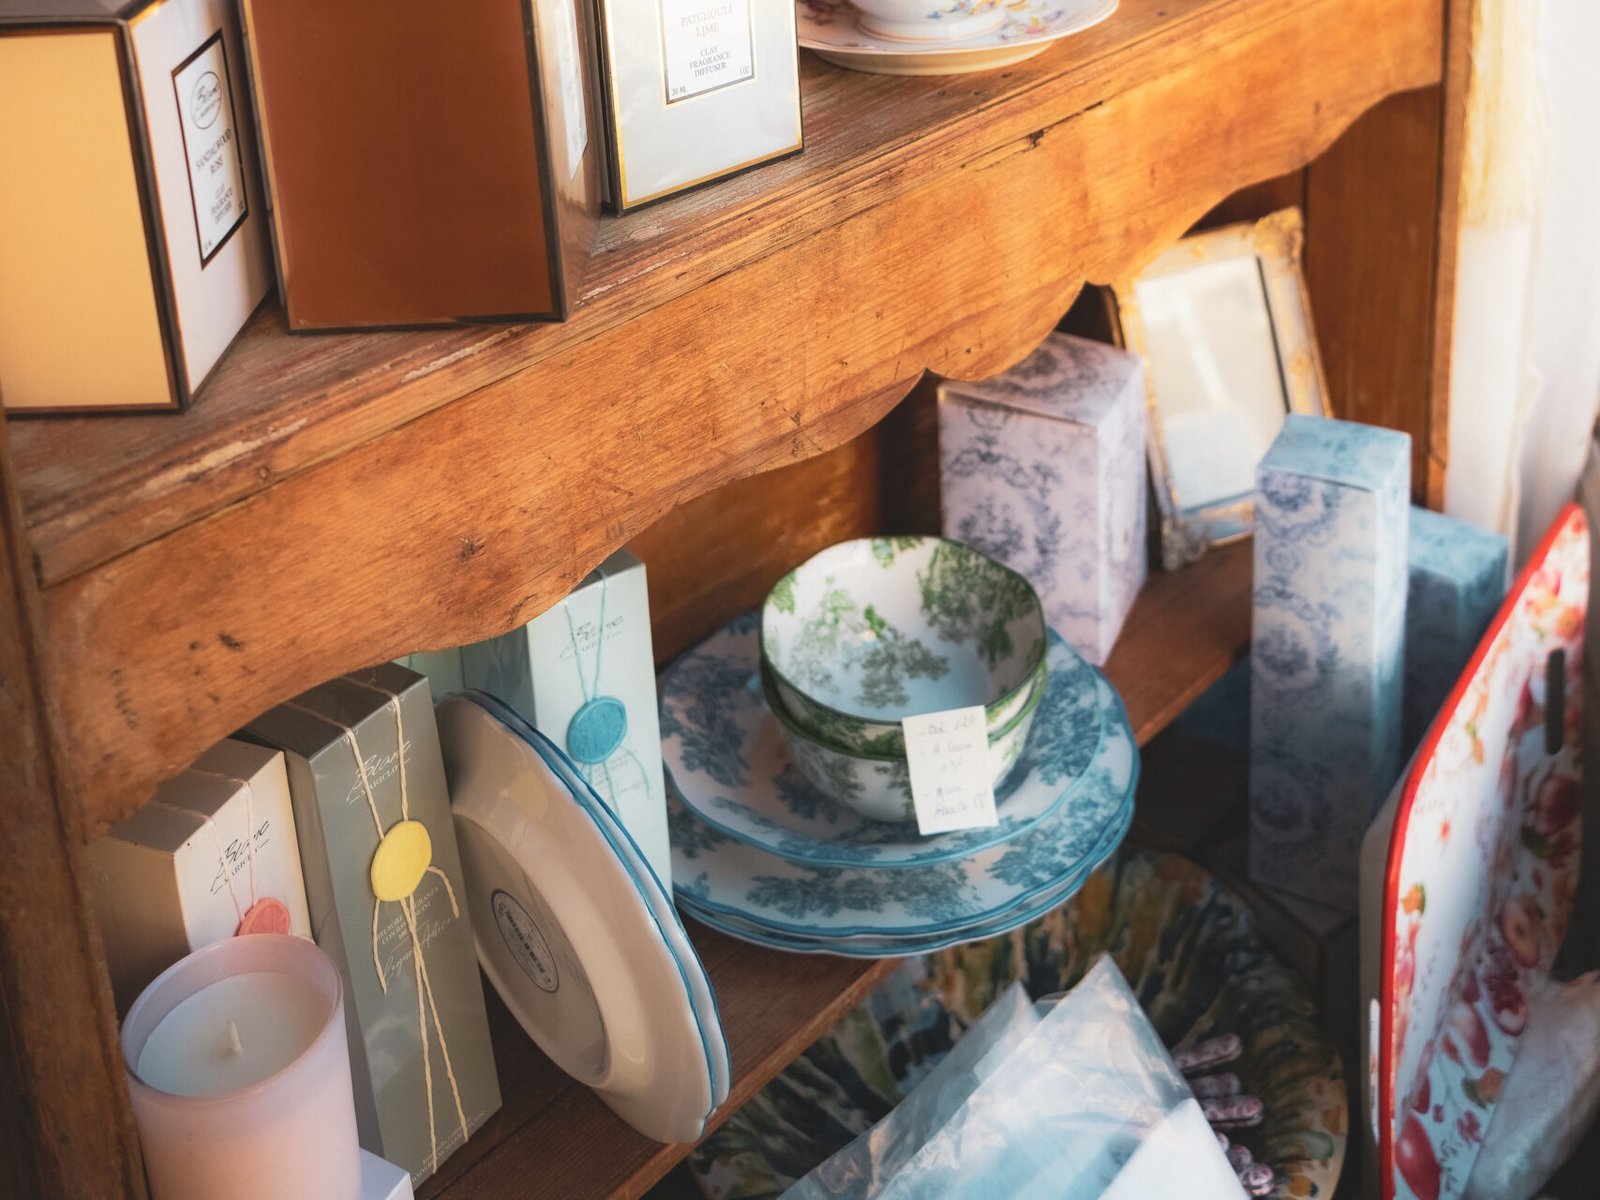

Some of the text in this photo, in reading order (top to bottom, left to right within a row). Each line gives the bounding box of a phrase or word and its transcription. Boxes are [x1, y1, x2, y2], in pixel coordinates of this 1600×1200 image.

[680, 4, 733, 28] PATCHOULI
[696, 22, 720, 38] LIME
[689, 50, 731, 70] FRAGRANCE
[700, 45, 719, 57] CLAY
[694, 61, 727, 78] DIFFUSER
[210, 820, 269, 892] Blanc
